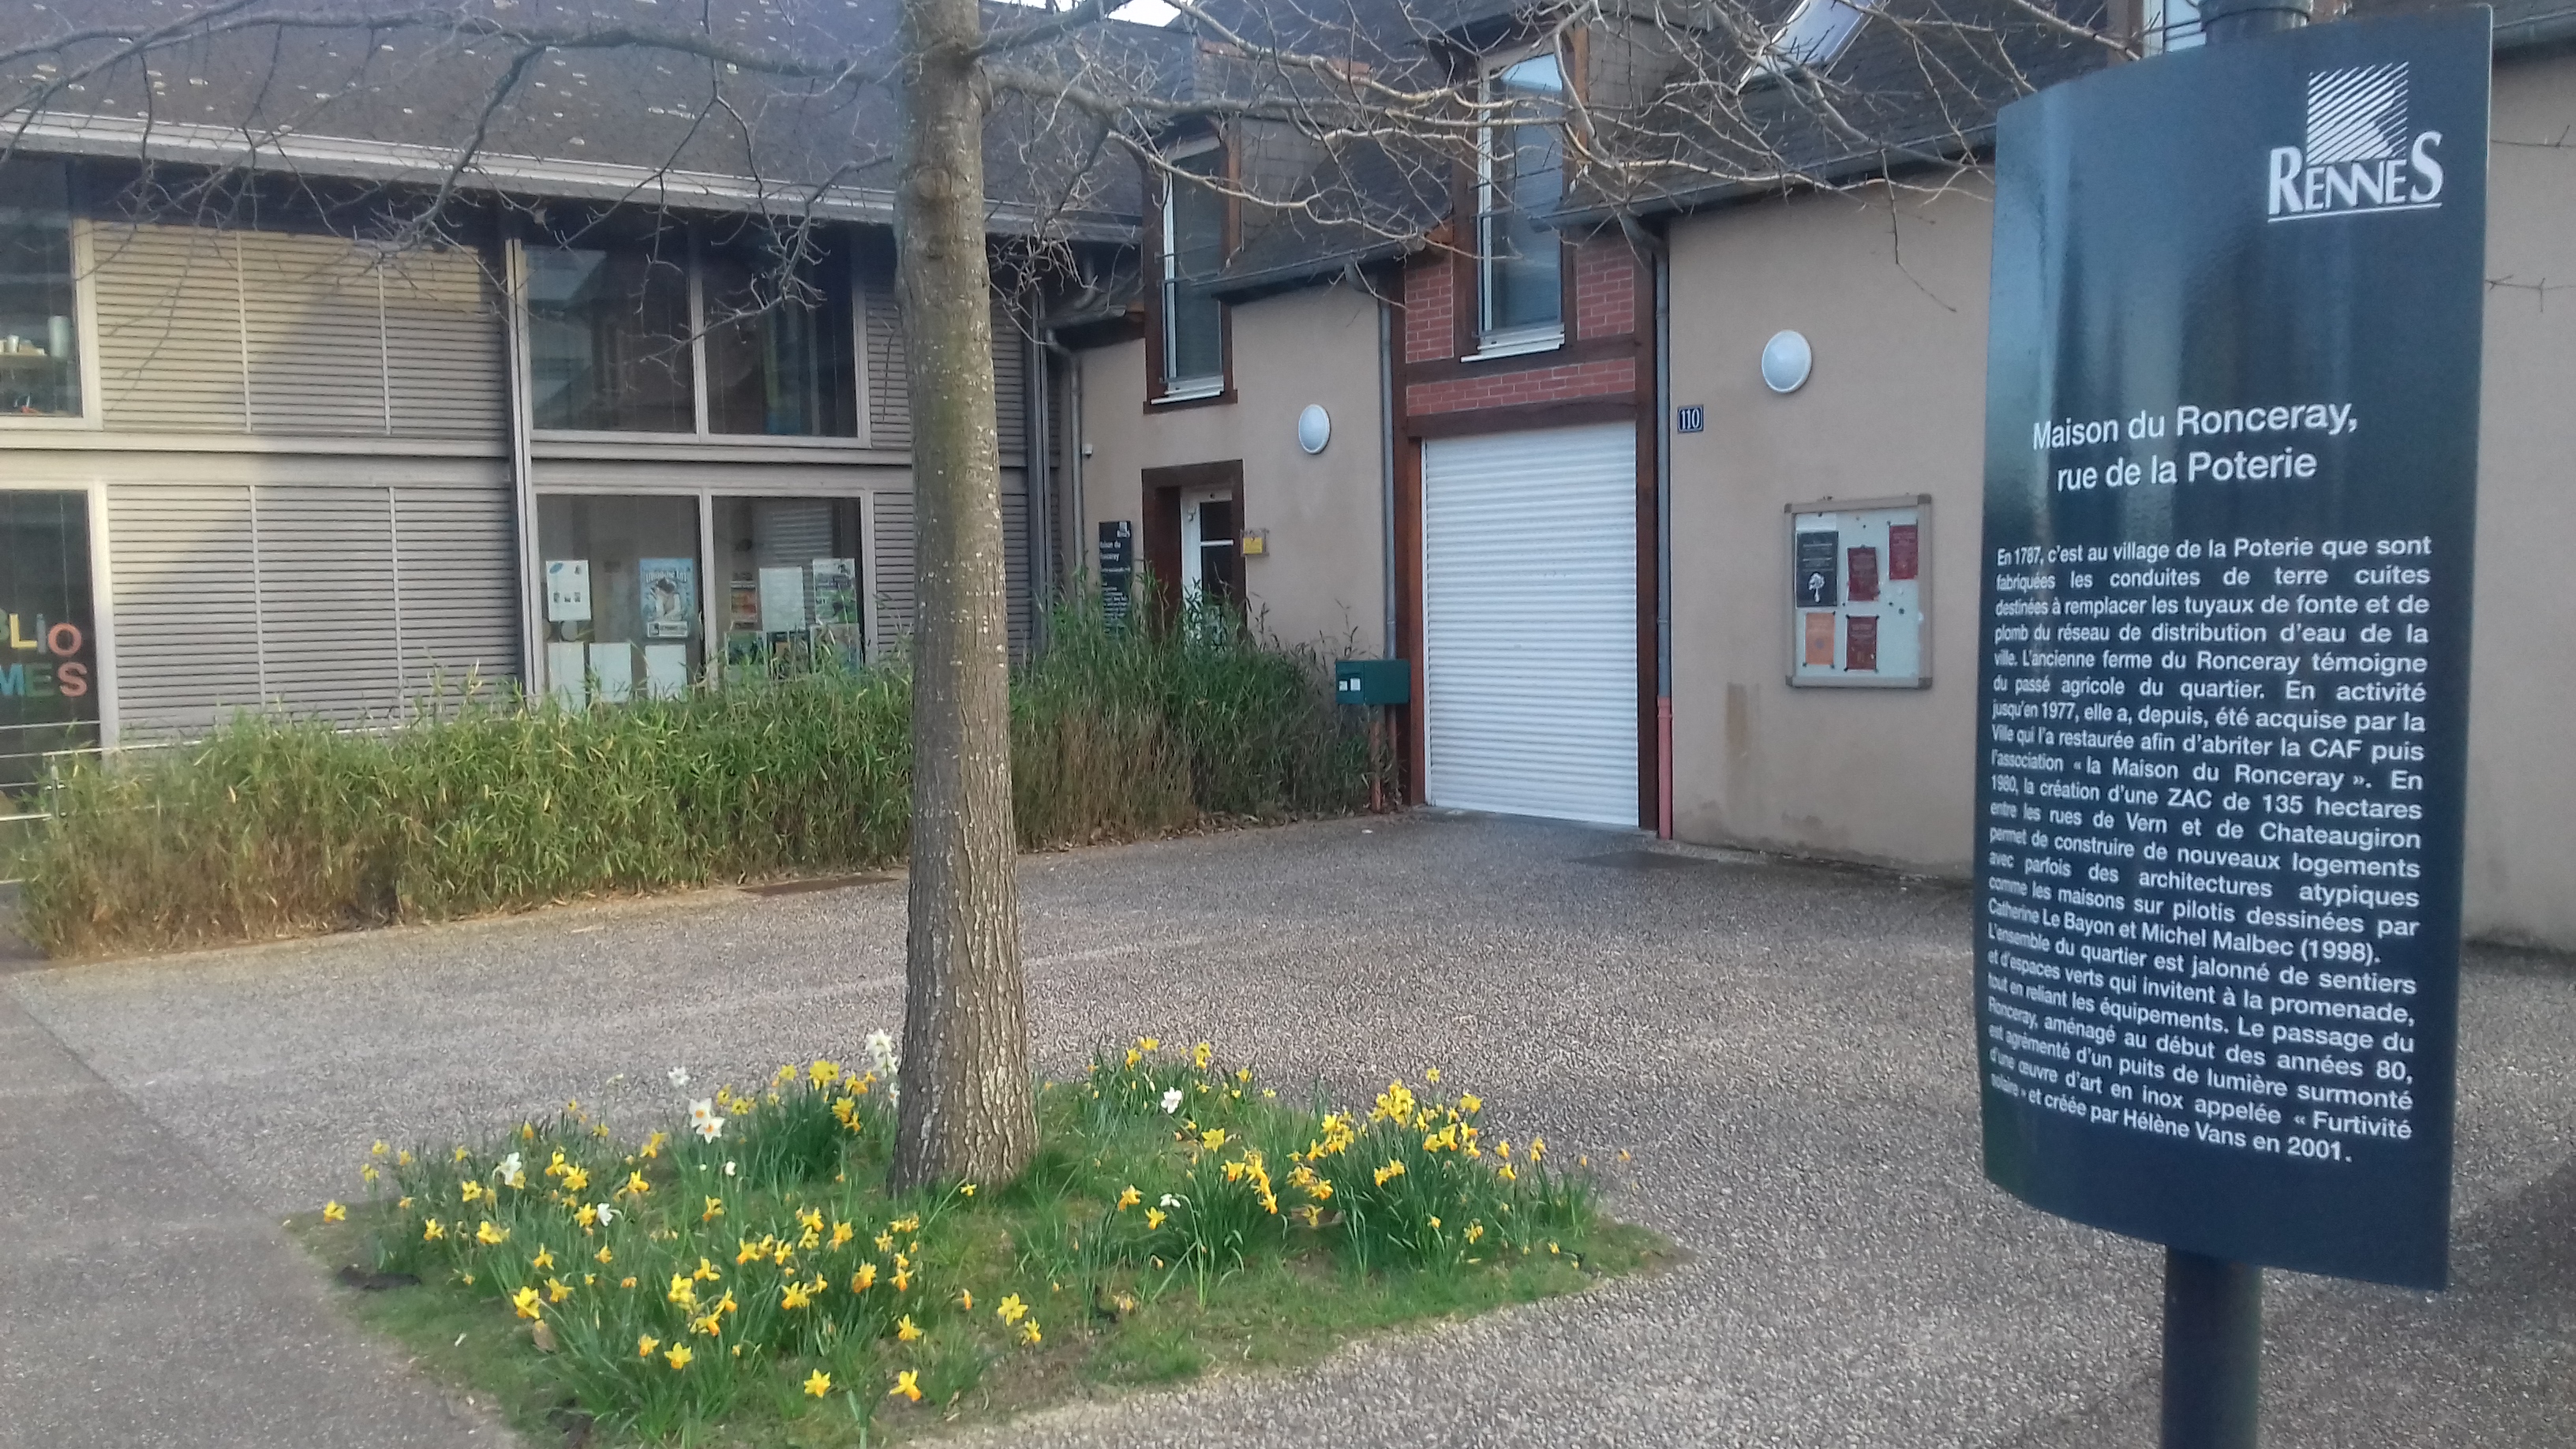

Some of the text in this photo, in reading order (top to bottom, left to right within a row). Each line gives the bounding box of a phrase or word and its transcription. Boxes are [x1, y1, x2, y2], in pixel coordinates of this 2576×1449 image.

[2267, 130, 2444, 215] RENNES
[1681, 409, 1700, 430] 110
[2032, 403, 2358, 451] Maison du Ronceray,
[2057, 447, 2318, 492] rue de la Poterie
[1998, 536, 2432, 567] En 1787, c'est au village de la Poterie que sont
[2070, 564, 2431, 588] les conduites de terre cuites
[2051, 594, 2430, 619] à remplacer les tuyaux de fonte et de
[2033, 622, 2428, 644] du réseau de distribution d'eau de la
[2023, 649, 2428, 677] L'ancienne ferme du Ronceray témoigne
[1994, 675, 2427, 702] du passé agricole du quartier. En activité
[2042, 702, 2079, 723] 1977,
[2084, 702, 2113, 722] elle
[2117, 707, 2132, 725] a,
[2138, 704, 2208, 728] depuis,
[2215, 706, 2249, 727] été
[2256, 710, 2347, 733] acquise
[2354, 715, 2397, 735] par
[2403, 711, 2425, 732] la
[2016, 726, 2425, 765] qui l'a restaurée afin d'abriter la CAF puis
[2087, 755, 2423, 792] la Maison du Ronceray En
[2024, 778, 2422, 819] la création d'une ZAC de 135 hectares
[2031, 829, 2421, 878] de construire de nouveaux logements
[2050, 810, 2421, 852] rues de Vern et de Chateaugiron
[2025, 856, 2420, 909] parfois des architectures atypiques
[2032, 881, 2421, 939] les maisons sur pilotis dessinées par
[2042, 908, 2380, 967] Le Bayon et Michel Malbec (1998).
[2055, 937, 2417, 995] du quartier est jalonné de sentiers
[2065, 968, 2415, 1027] verts qui invitent à la promenade,
[2072, 991, 2414, 1053] les équipements. Le passage du
[2044, 1017, 2413, 1084] aménagé au début des années 80,
[2018, 1061, 2412, 1140] œuvre d'art en inox appelée Furtivité
[2076, 1046, 2413, 1110] d'un puits de lumière surmonté
[2028, 1088, 2352, 1163] et créée par Hélène Vans en 2001.
